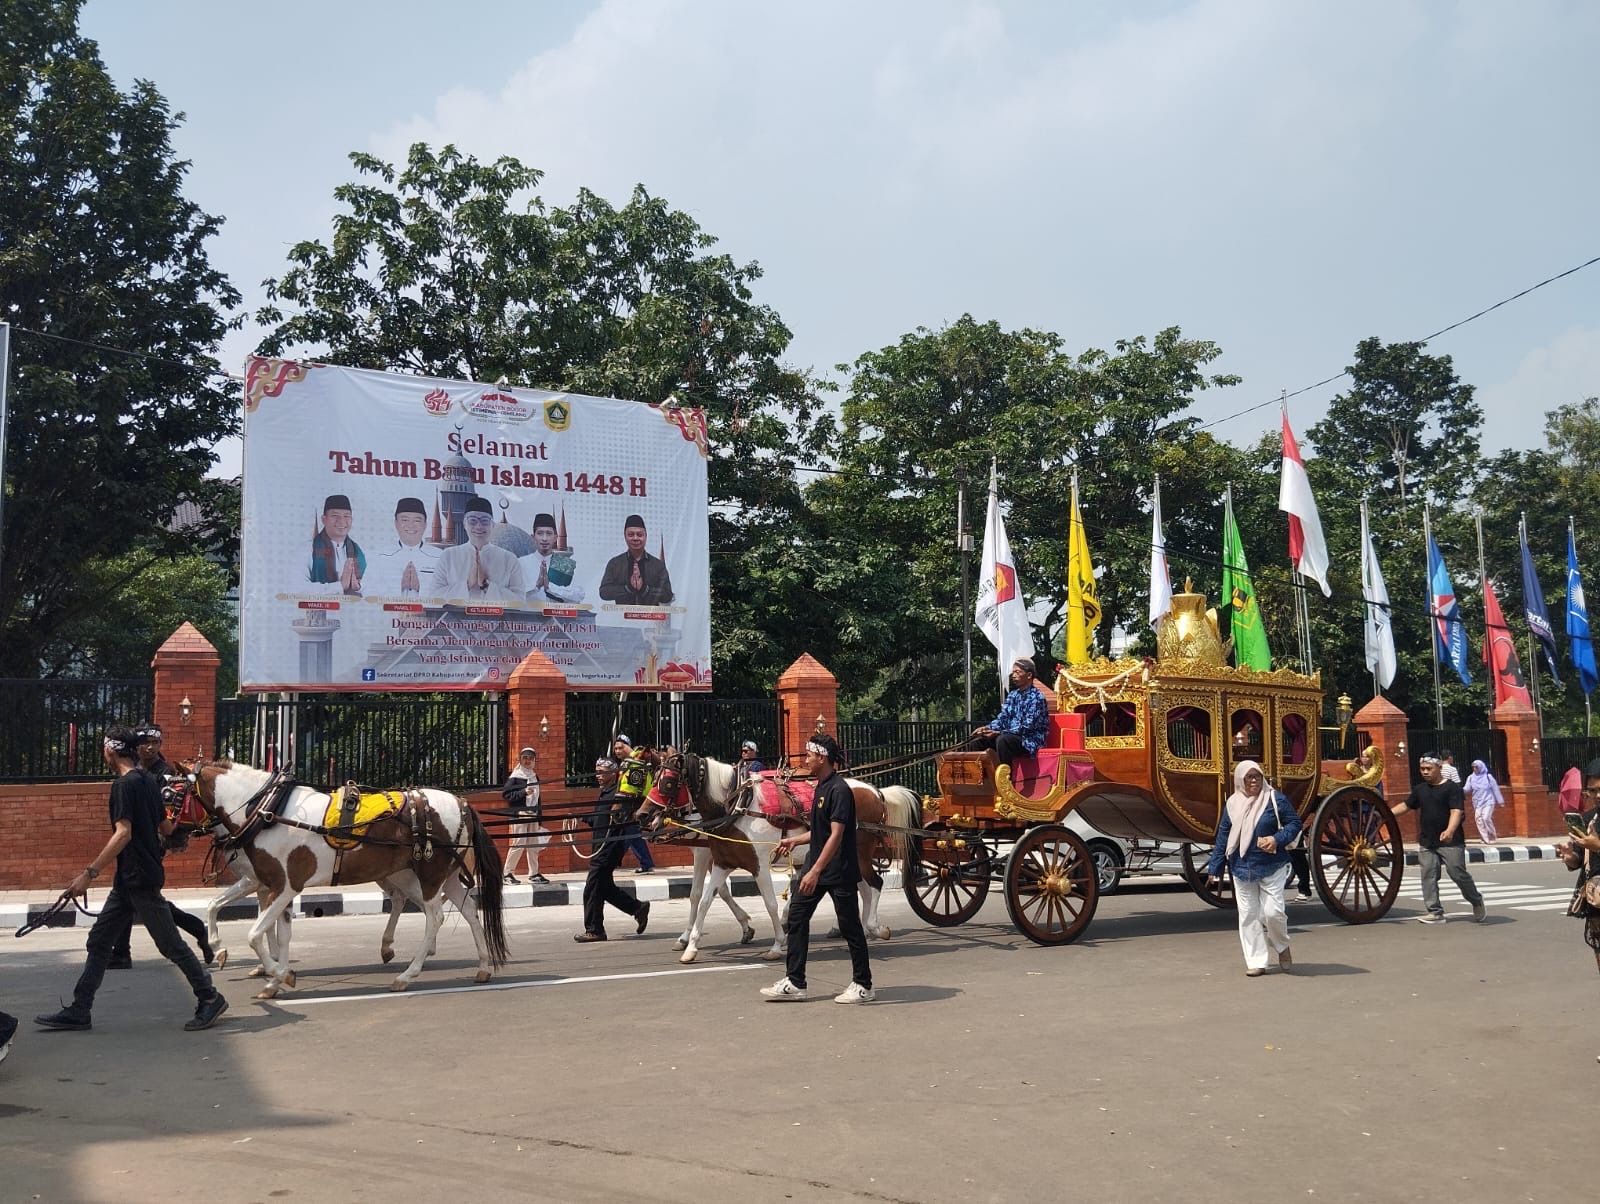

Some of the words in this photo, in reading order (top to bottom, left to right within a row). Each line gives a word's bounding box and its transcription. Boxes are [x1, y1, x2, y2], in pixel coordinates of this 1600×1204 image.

[448, 432, 548, 460] Selamat
[329, 450, 417, 478] Tahun
[423, 458, 485, 484] Baru
[491, 464, 559, 491] Islam
[564, 471, 624, 496] 1448
[629, 476, 647, 497] H
[392, 618, 436, 630] Dengan
[439, 620, 497, 632] Semangat
[503, 621, 560, 633] Muharram
[386, 635, 438, 646] Bersama
[441, 636, 508, 650] Membangun
[512, 638, 569, 651] Kabupaten
[571, 640, 602, 651] Bogor
[419, 653, 448, 665] Yang
[450, 653, 501, 664] Istimewa
[502, 655, 521, 664] dan
[551, 656, 574, 666] ilang
